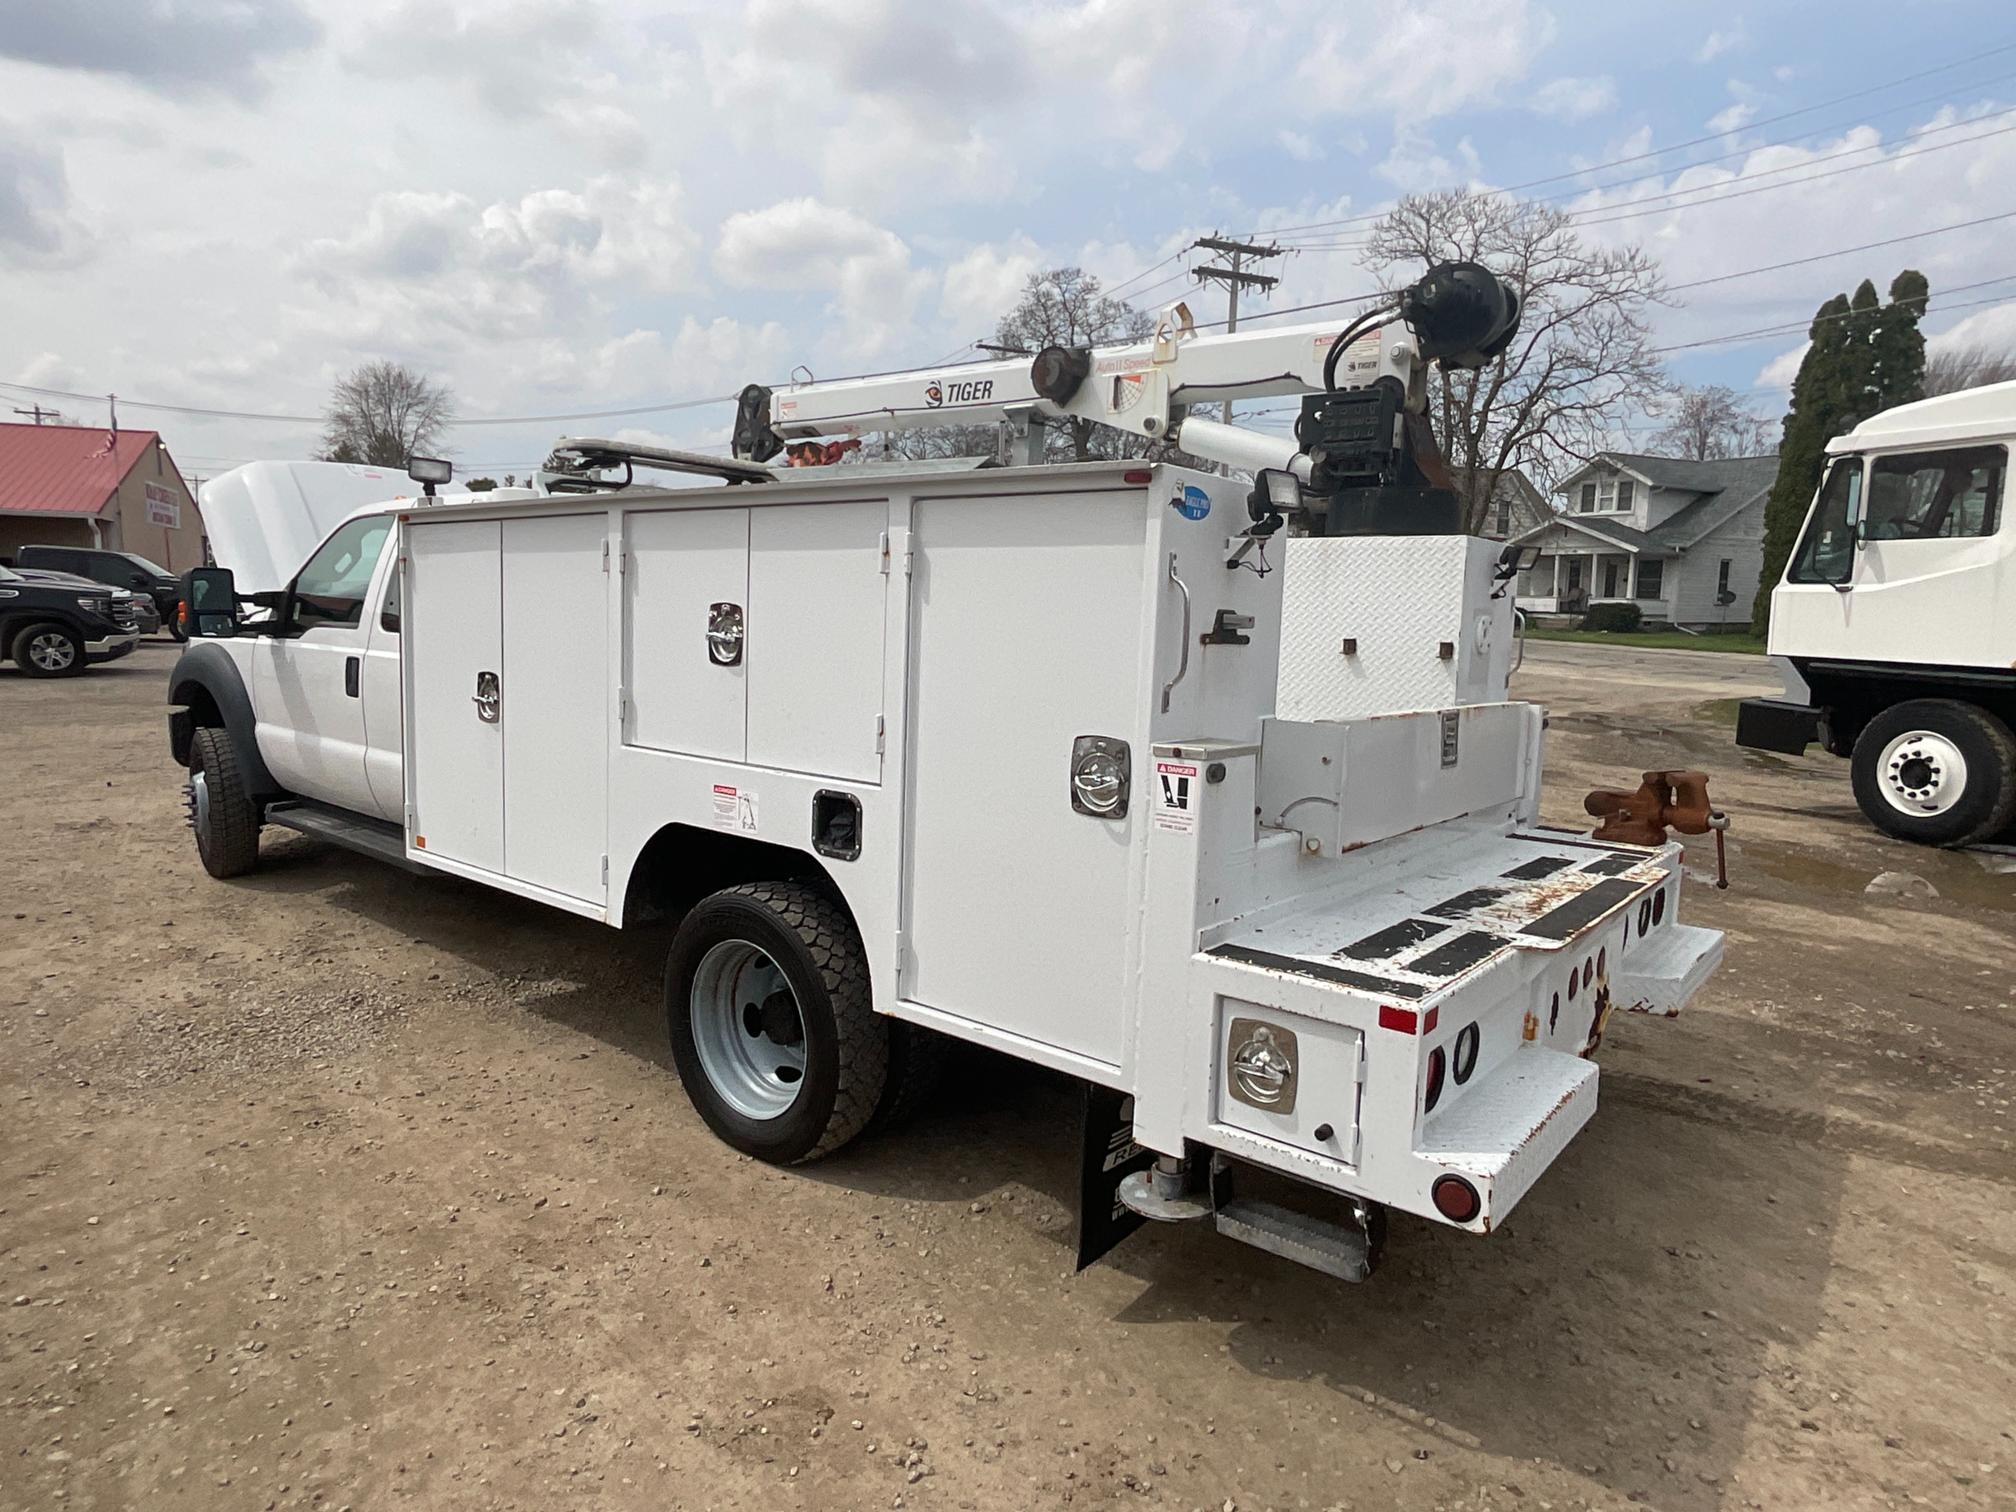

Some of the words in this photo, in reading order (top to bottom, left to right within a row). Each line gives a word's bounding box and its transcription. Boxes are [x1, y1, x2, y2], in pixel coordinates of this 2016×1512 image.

[1357, 361, 1378, 370] TIGER
[947, 380, 994, 403] TIGER
[1167, 765, 1195, 776] DANGER
